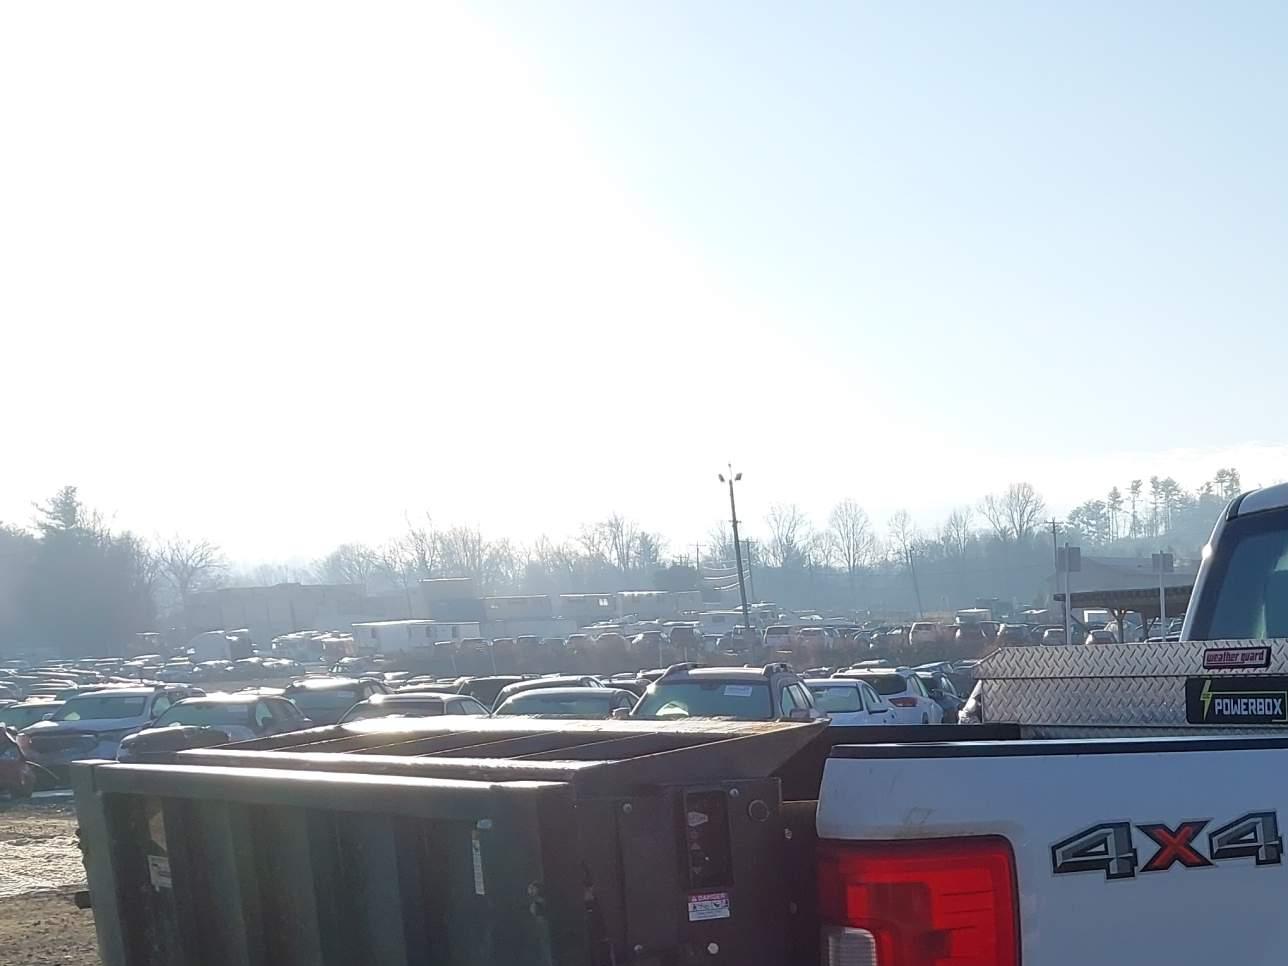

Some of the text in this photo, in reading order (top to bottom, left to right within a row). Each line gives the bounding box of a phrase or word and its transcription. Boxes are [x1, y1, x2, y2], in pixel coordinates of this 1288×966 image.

[1208, 650, 1264, 662] weather guard
[1214, 698, 1282, 715] POWERBOX
